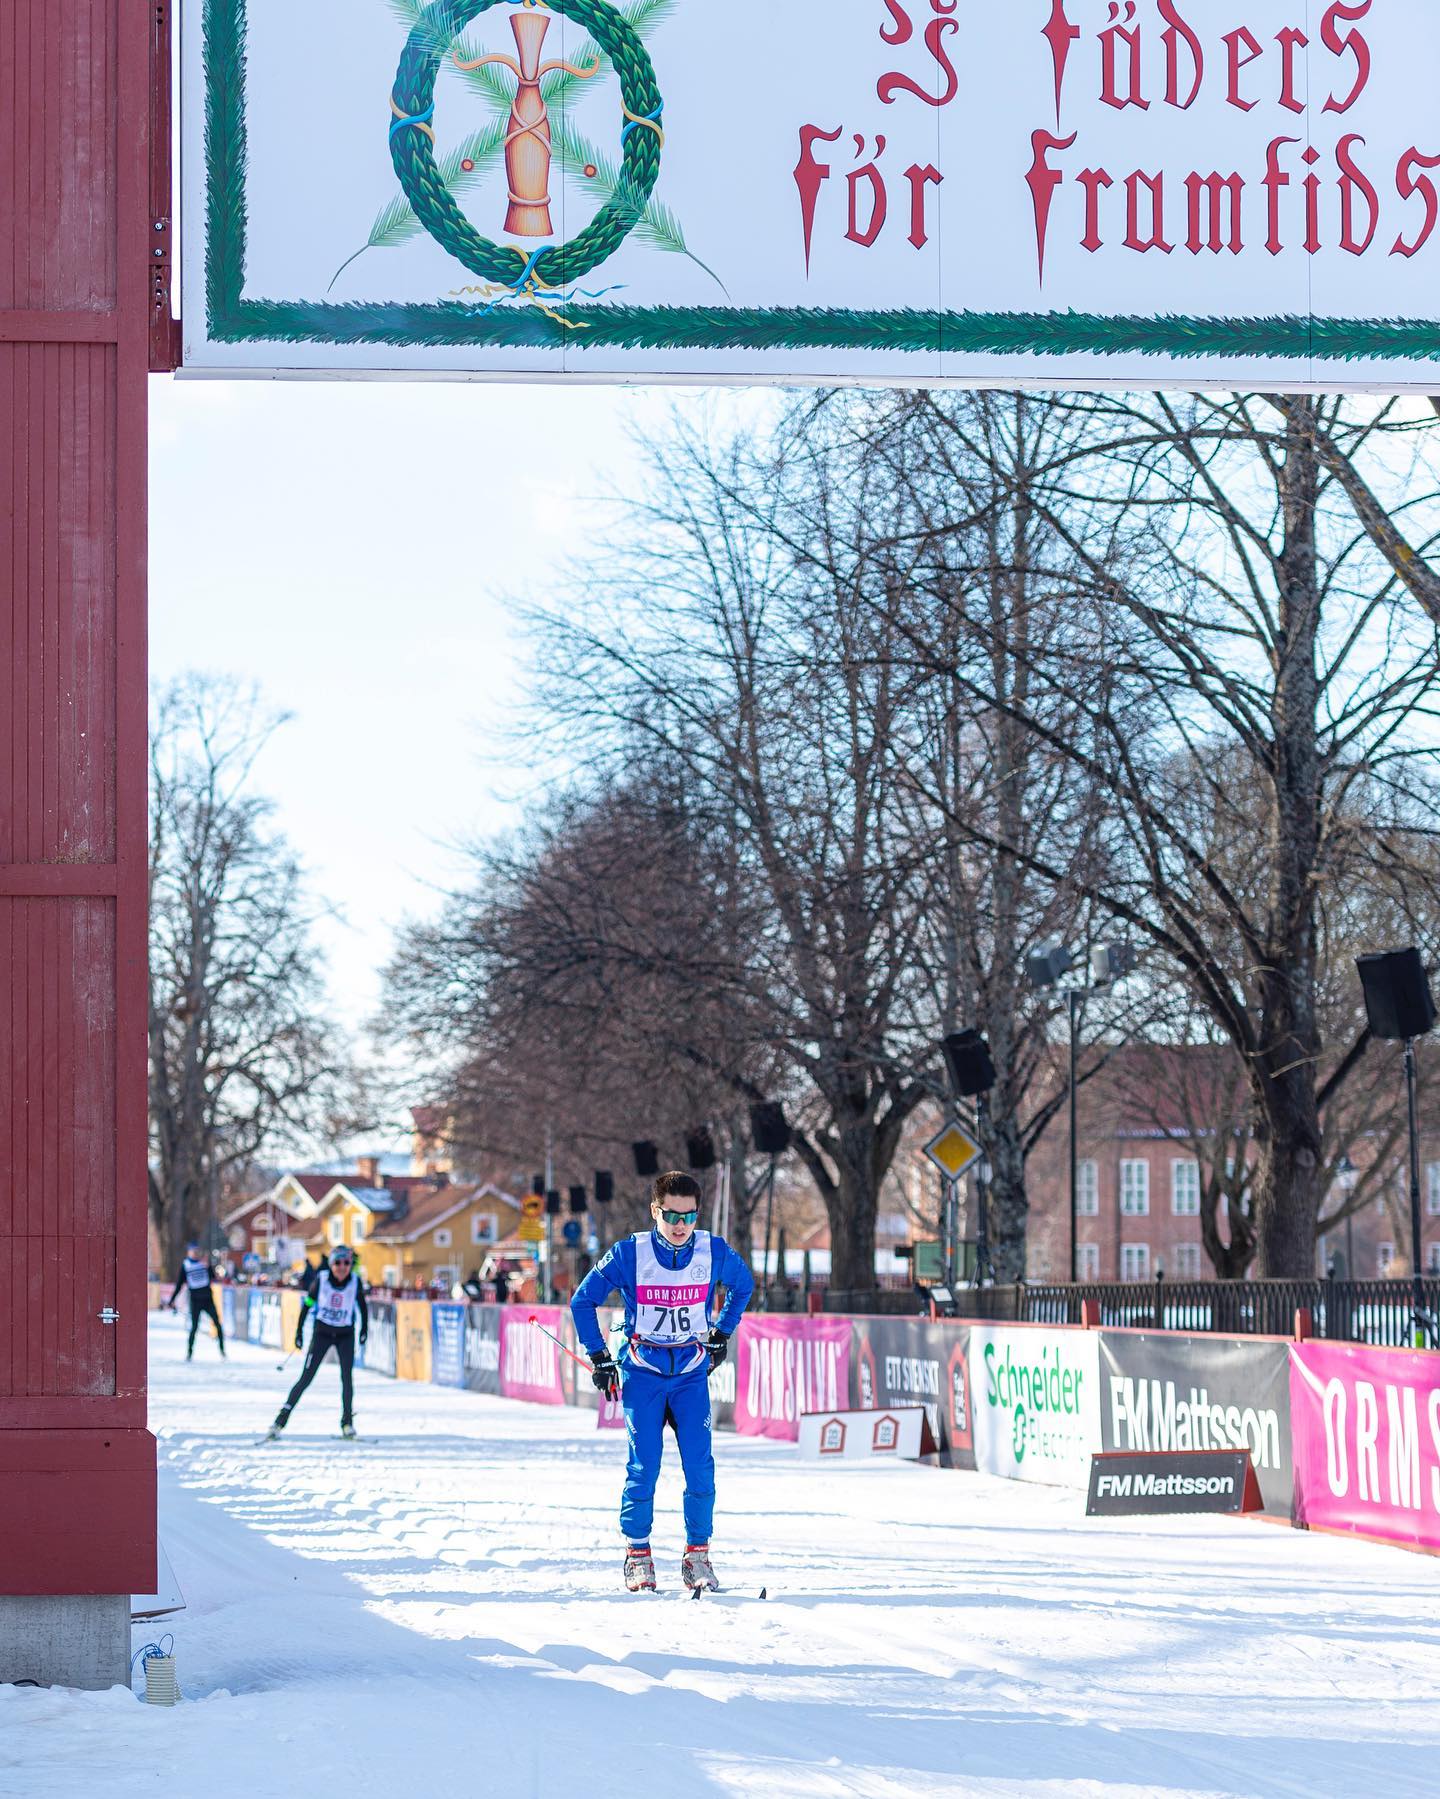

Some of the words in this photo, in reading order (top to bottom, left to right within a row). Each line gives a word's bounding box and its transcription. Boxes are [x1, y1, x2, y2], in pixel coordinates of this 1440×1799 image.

[646, 1288, 700, 1301] ORMSALVA
[653, 1306, 691, 1333] 716
[747, 1336, 838, 1423] ORMSALVA
[885, 1356, 902, 1390] ETT
[984, 1341, 1084, 1415] Schneider
